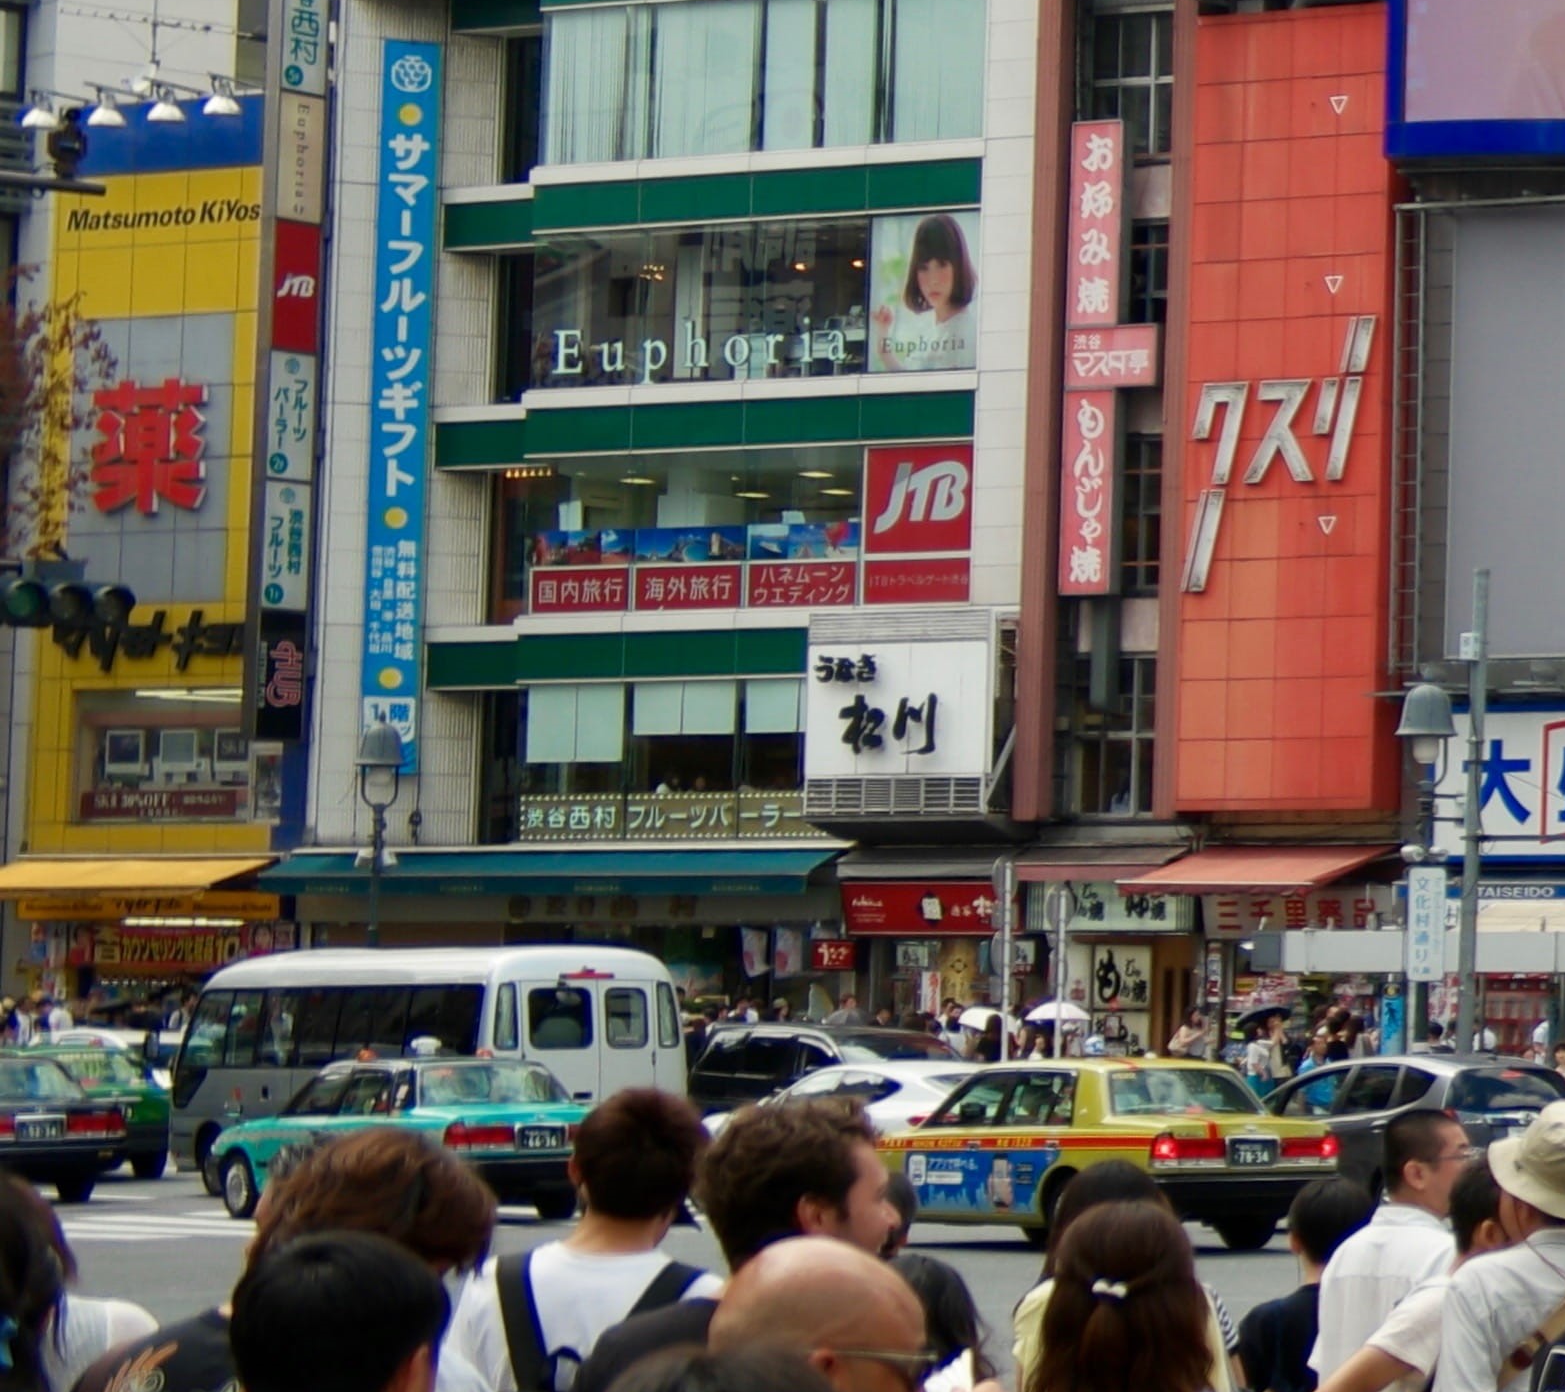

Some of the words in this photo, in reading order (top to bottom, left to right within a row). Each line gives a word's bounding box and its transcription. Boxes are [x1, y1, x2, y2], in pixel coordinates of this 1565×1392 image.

[67, 205, 195, 233] Matsumoto
[1077, 134, 1114, 315] お好み焼
[277, 272, 315, 299] JTB
[379, 133, 430, 497] サマーフルーツギフト
[552, 316, 849, 387] Euphoria
[882, 334, 967, 357] Euphoria
[91, 377, 207, 516] 薬
[1181, 316, 1378, 593] クスリ
[873, 459, 971, 535] JTB
[1070, 399, 1104, 584] もんじゃ焼
[538, 577, 624, 605] 国内旅行
[644, 574, 733, 602] 海外旅行
[759, 565, 845, 584] ハネムーン
[394, 539, 417, 661] 無料配送地域
[525, 804, 617, 831] 渋谷西村
[1476, 885, 1555, 898] TAISEIDO
